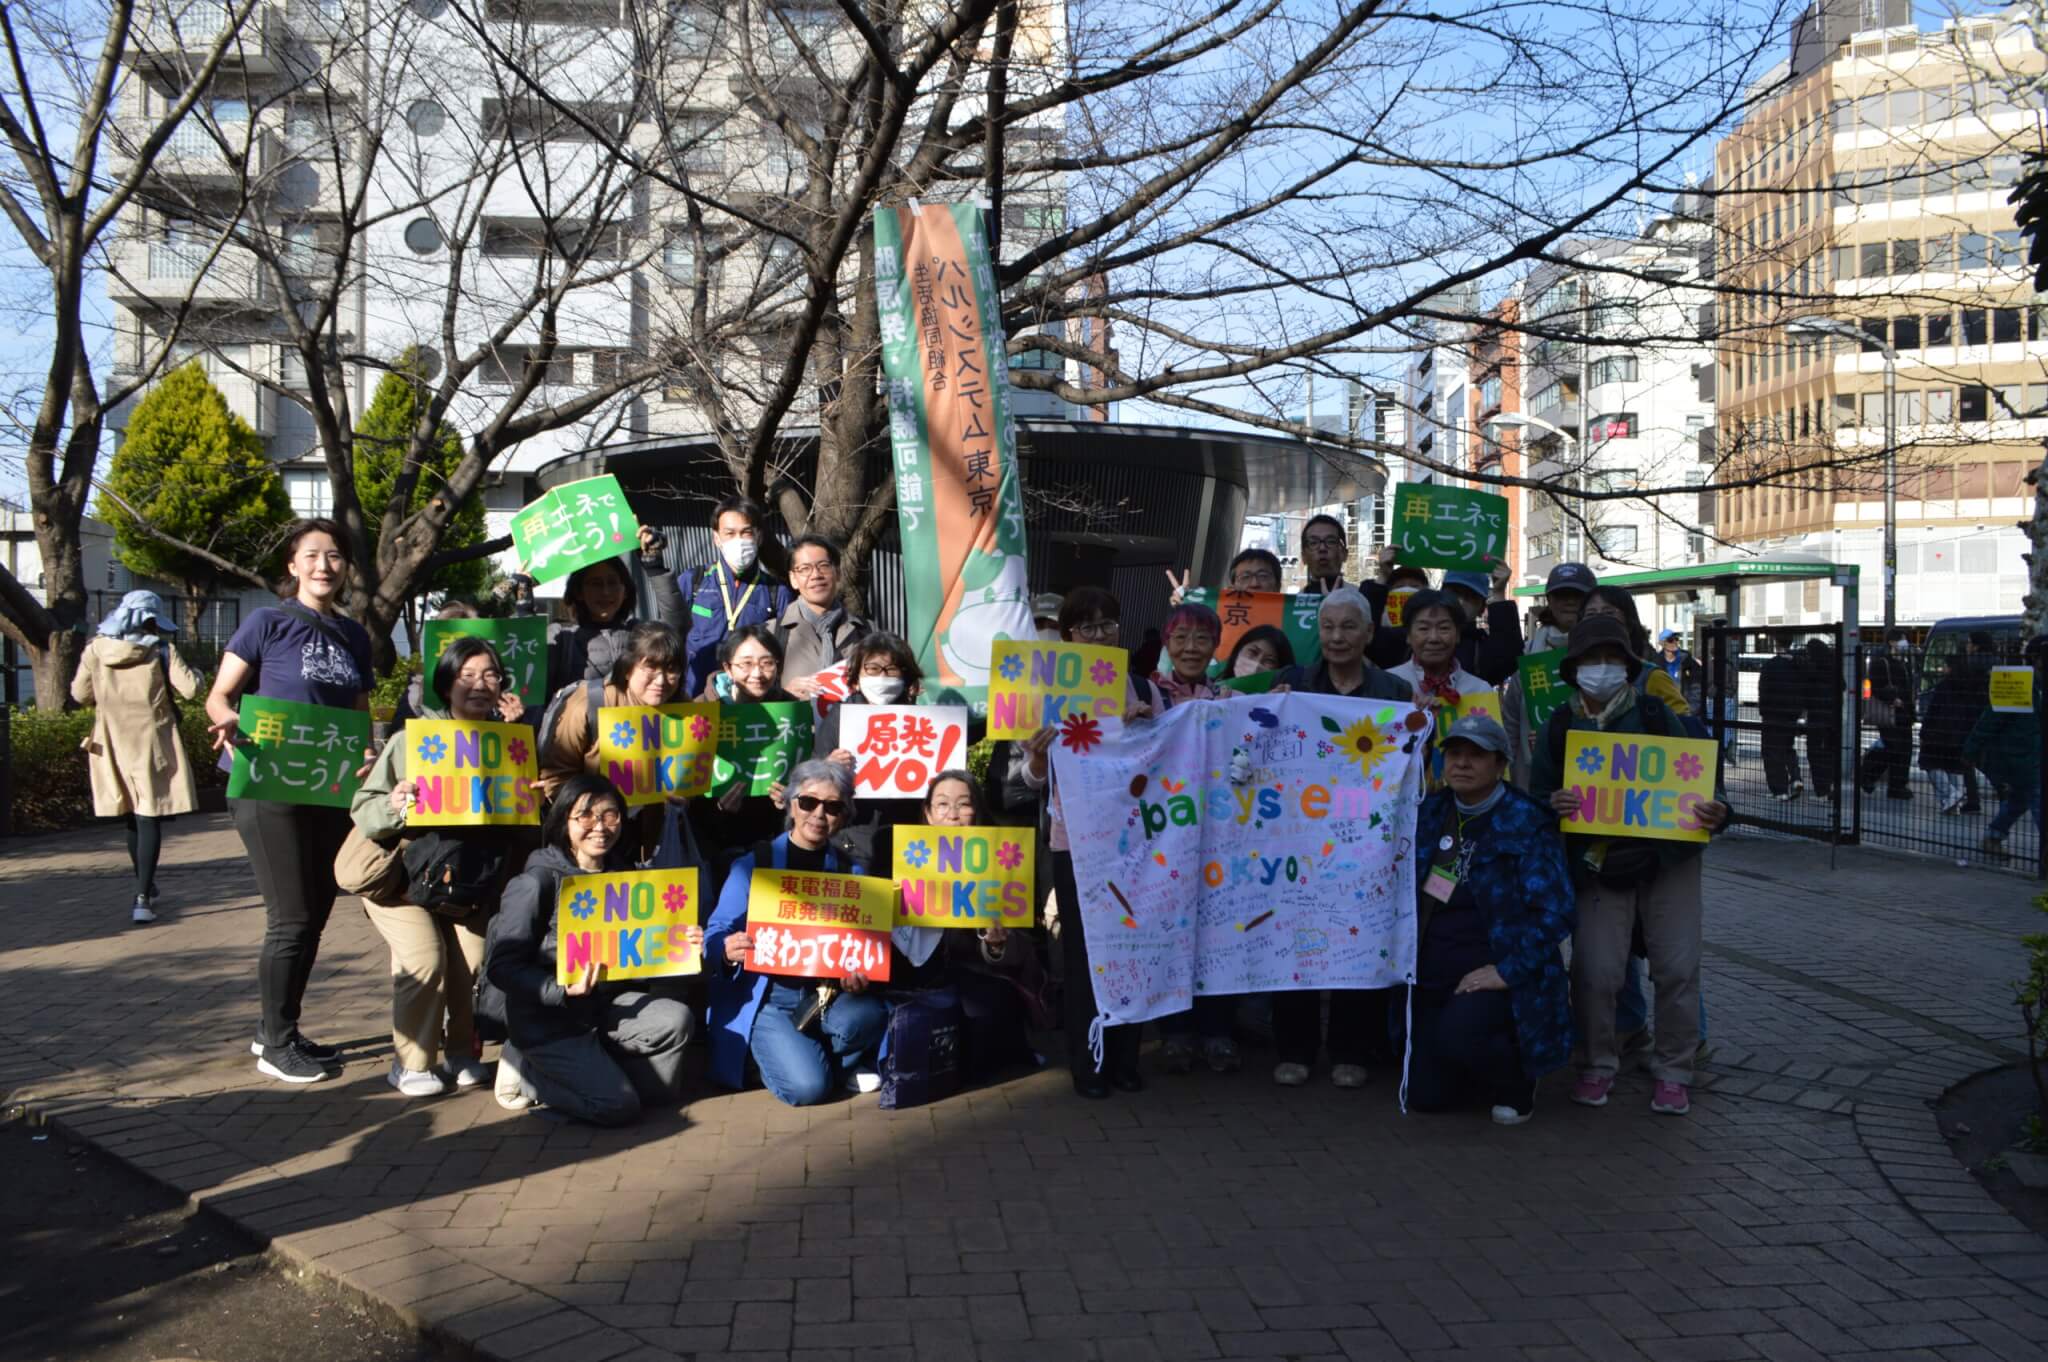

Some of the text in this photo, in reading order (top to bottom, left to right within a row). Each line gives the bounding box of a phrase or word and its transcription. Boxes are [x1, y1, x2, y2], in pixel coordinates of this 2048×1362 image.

[521, 493, 616, 544] 再エネで
[1402, 492, 1501, 527] 再エネで
[1404, 531, 1497, 563] いこう!
[1030, 650, 1082, 688] NO
[249, 710, 359, 752] 再エネで
[455, 729, 501, 769] NO
[641, 713, 684, 751] NO
[864, 713, 938, 754] 原発
[250, 757, 351, 792] いこう!
[608, 753, 711, 796] NUKES
[854, 725, 961, 793] NO!
[1610, 742, 1666, 783] NO
[415, 775, 536, 815] NUKES
[1568, 784, 1703, 830] NUKES
[937, 836, 989, 874] NO
[603, 882, 655, 922] NO
[780, 874, 862, 900] 東電福島
[899, 880, 1028, 918] NUKES
[777, 899, 873, 926] 原発事故は
[566, 926, 692, 974] NUKES
[753, 929, 885, 971] 終わってない
